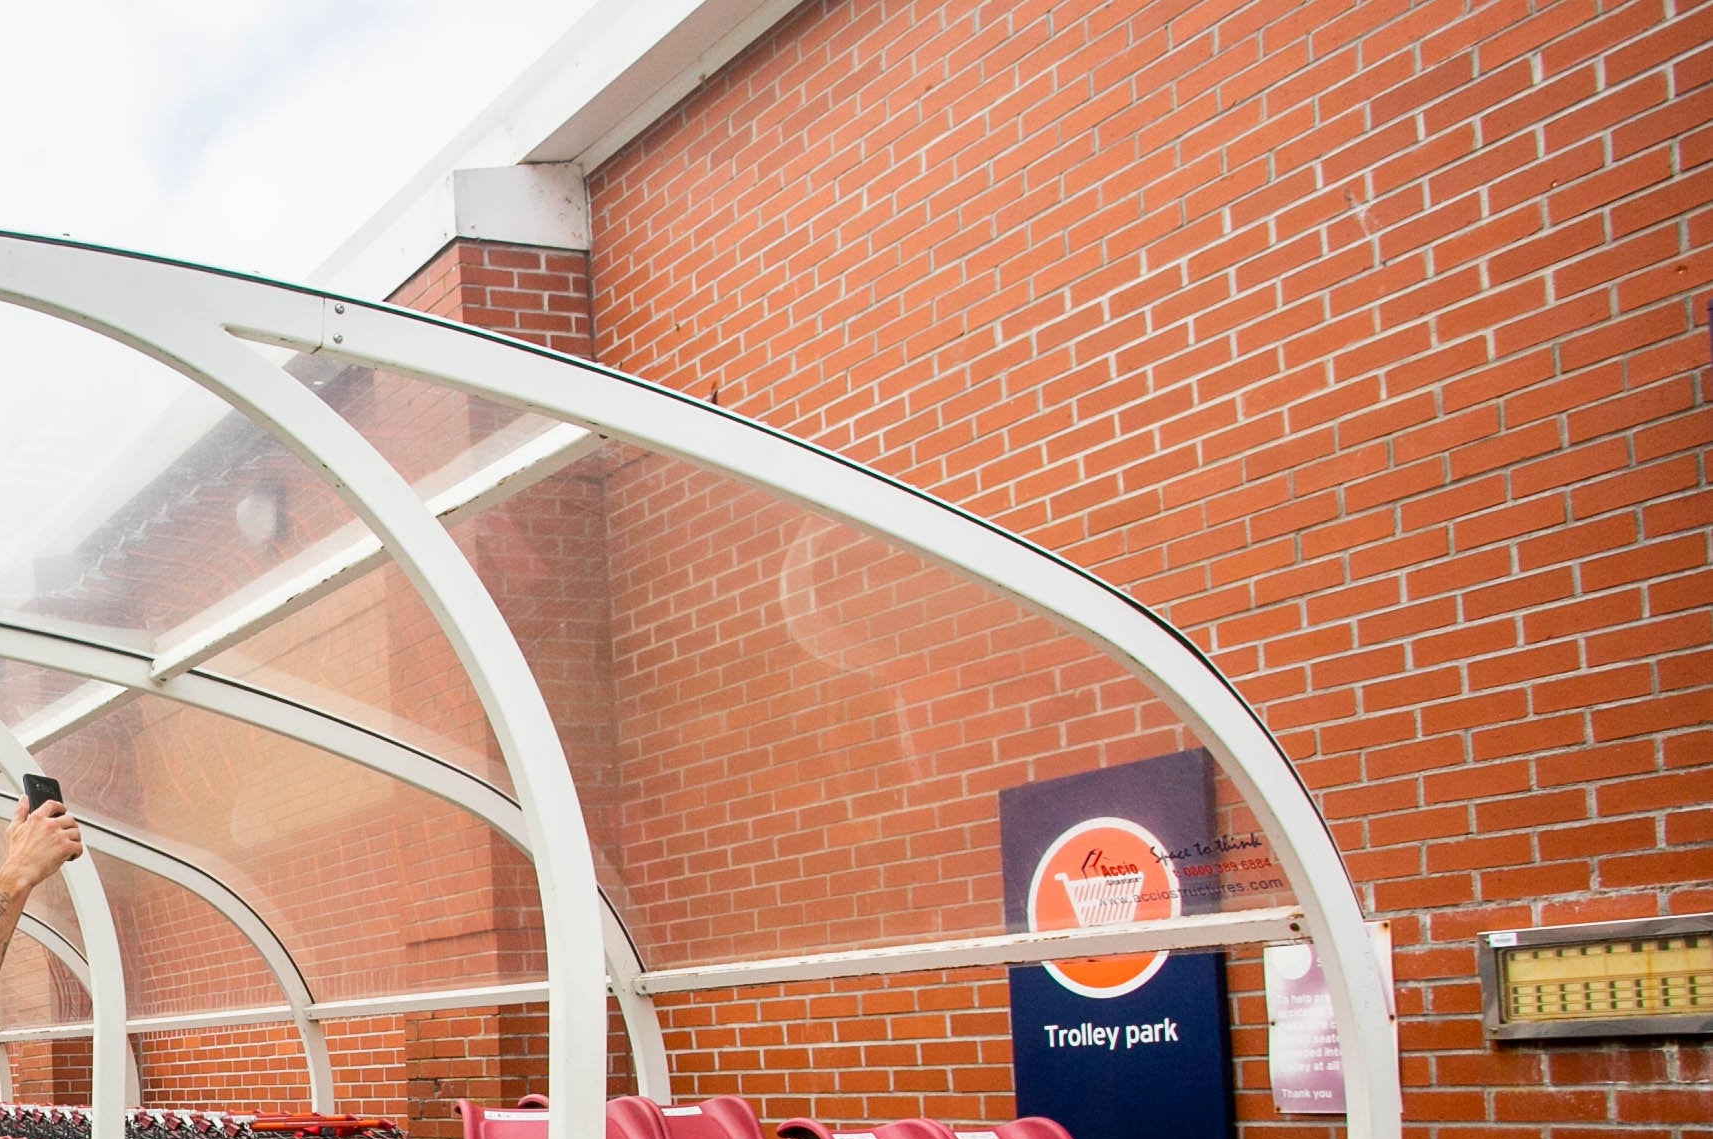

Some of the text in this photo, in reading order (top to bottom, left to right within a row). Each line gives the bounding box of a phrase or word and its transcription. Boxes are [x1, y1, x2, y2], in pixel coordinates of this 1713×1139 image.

[1183, 865, 1214, 877] 0800
[1044, 1017, 1179, 1051] Trolley park
[1281, 1088, 1333, 1100] Thank you
